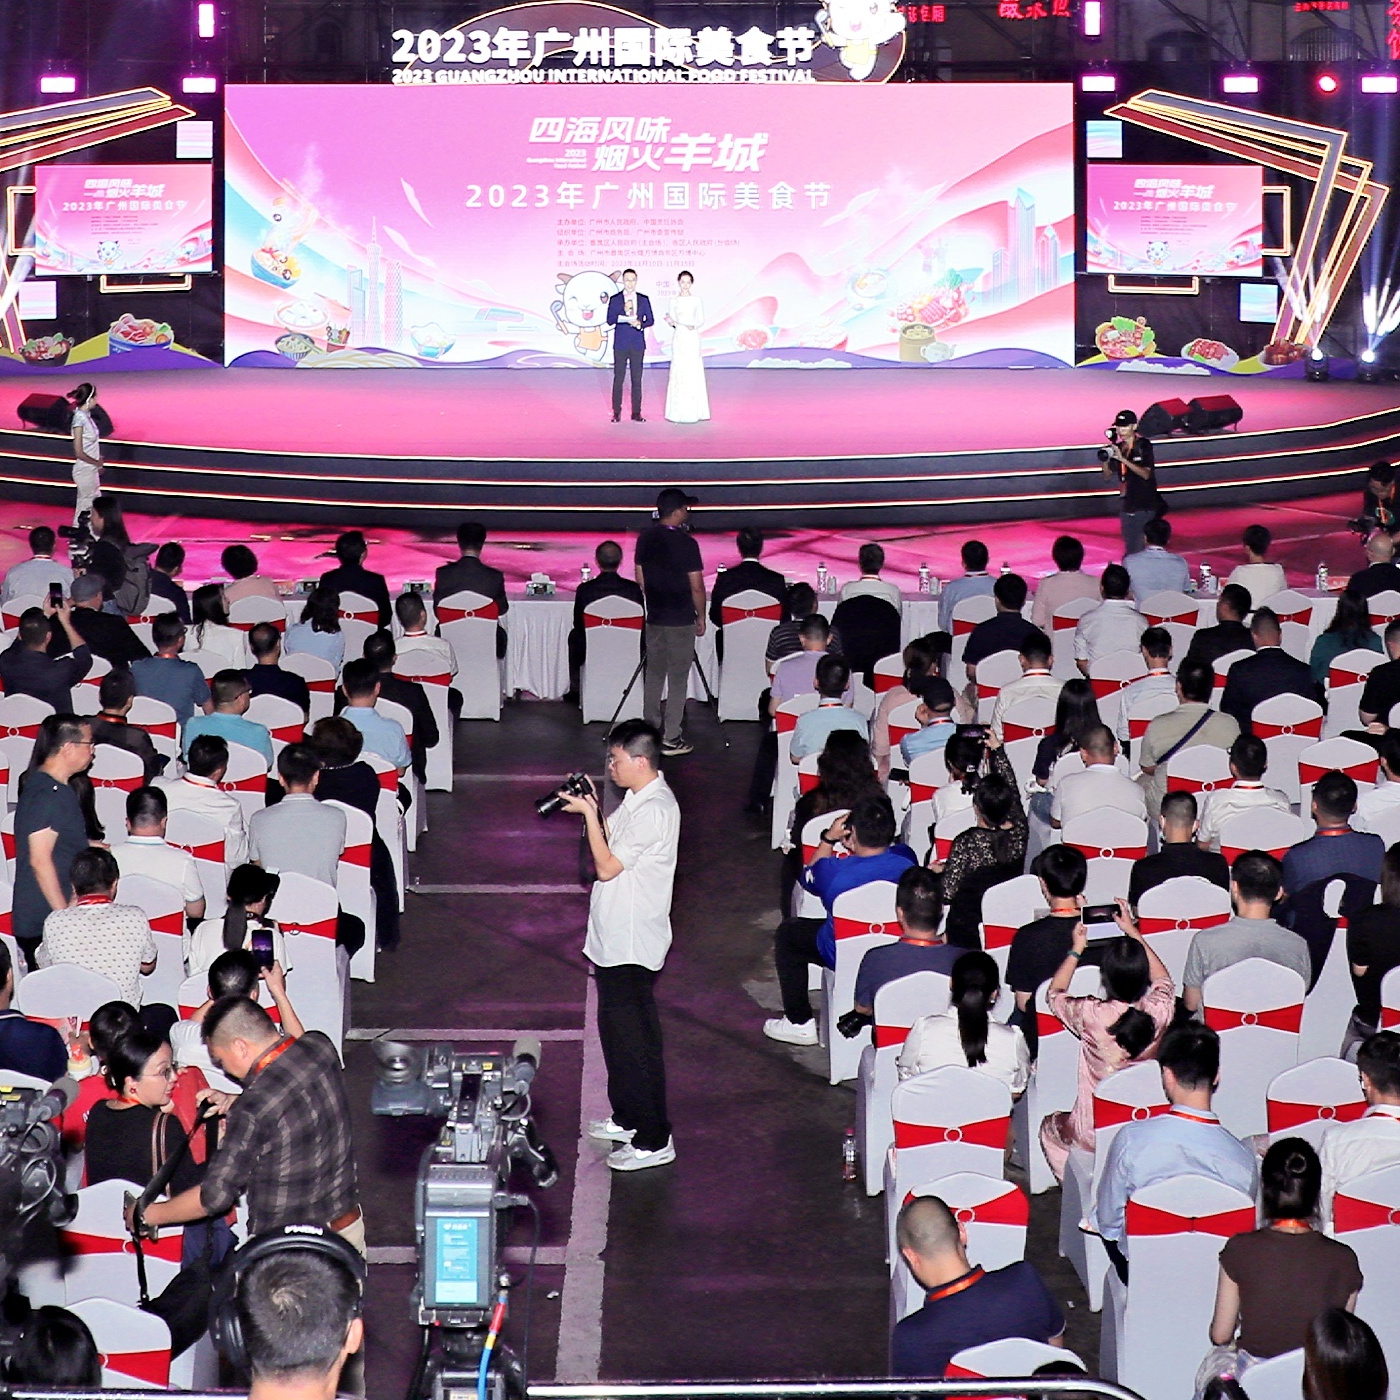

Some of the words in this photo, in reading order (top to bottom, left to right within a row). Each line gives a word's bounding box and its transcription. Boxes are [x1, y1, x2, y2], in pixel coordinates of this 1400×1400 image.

[391, 25, 815, 67] 2023年广州国际美食节
[391, 68, 432, 83] 2023
[436, 68, 546, 84] GUANGZHOU
[548, 68, 689, 84] INTERNATIONAL
[740, 69, 816, 84] FESTIVAL
[528, 116, 672, 144] 四海风味
[591, 132, 769, 172] 烟火羊城
[465, 181, 831, 210] 2023年广州国际美食节
